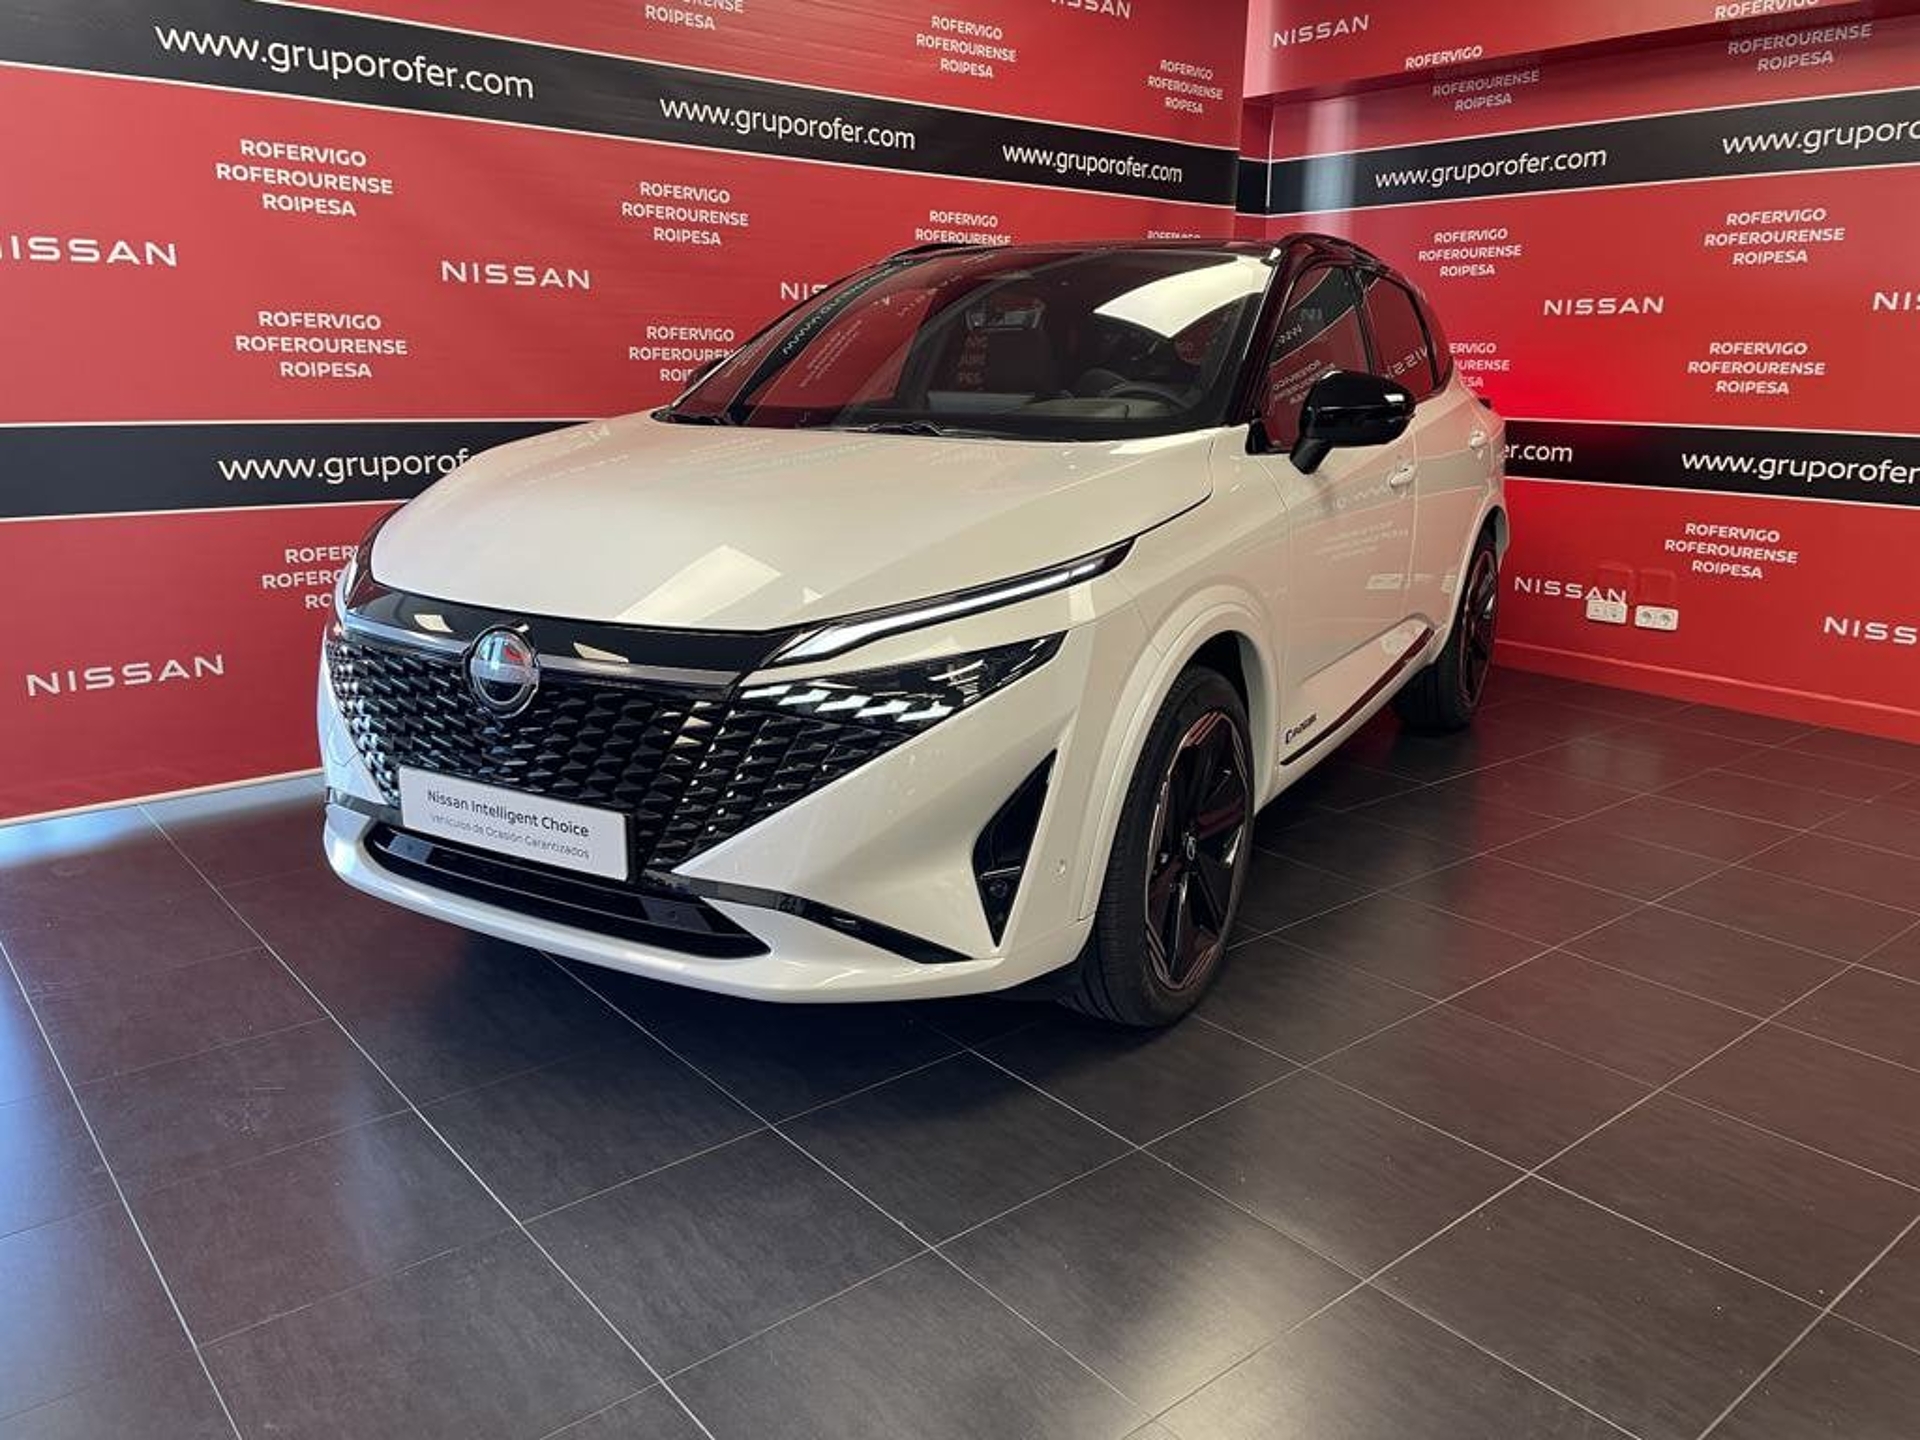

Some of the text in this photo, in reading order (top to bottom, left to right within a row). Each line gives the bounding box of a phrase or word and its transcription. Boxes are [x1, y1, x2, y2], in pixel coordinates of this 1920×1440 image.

[645, 5, 716, 30] ROIPESA
[1051, 0, 1131, 19] SSAN
[931, 15, 1003, 41] ROFERVIGO
[1272, 14, 1370, 48] NISSAN
[916, 33, 1016, 63] ROFEROURENSE
[1728, 24, 1873, 55] ROFEROURENSE
[155, 26, 535, 99] www.gruporofer.com
[1405, 44, 1484, 70] ROFERVIGO
[1757, 50, 1834, 72] ROIPESA
[940, 58, 994, 79] ROIPESA
[1159, 59, 1214, 81] ROFERVIGO
[1147, 75, 1224, 100] ROFEROURENSE
[1431, 69, 1541, 98] ROFEROURENSE
[1164, 97, 1204, 114] ROIPESA
[1453, 93, 1513, 112] ROIPESA
[660, 98, 916, 151] www.gruporofer.com
[1722, 120, 1920, 155] www.gruporo
[239, 138, 367, 168] ROFERVIGO
[1002, 143, 1184, 184] www.gruporofer.com
[215, 162, 394, 195] ROFEROURENSE
[1375, 147, 1608, 189] www.gruporofer.com
[639, 181, 731, 204] ROFERVIGO
[262, 192, 357, 217] ROIPESA
[621, 201, 749, 228] ROFEROURENSE
[929, 209, 998, 228] ROFERVIGO
[1726, 207, 1827, 226] ROFERVIGO
[653, 226, 722, 246] ROIPESA
[1433, 227, 1508, 244] ROFERVIGO
[1704, 227, 1846, 247] ROFEROURENSE
[0, 235, 177, 267] ISSAN
[1418, 244, 1522, 262] ROFEROURENSE
[1732, 249, 1808, 266] ROIPESA
[441, 260, 591, 290] NISSAN
[1439, 263, 1496, 278] ROIPESA
[1543, 296, 1664, 316] NISSAN
[258, 310, 382, 332] ROFERVIGO
[646, 325, 735, 342] ROFERVIGO
[235, 335, 408, 356] ROFEROURENSE
[1450, 342, 1497, 355] ERVIGO
[1709, 341, 1808, 357] ROFERVIGO
[279, 361, 372, 378] ROIPESA
[1456, 359, 1511, 372] URENSE
[1687, 361, 1826, 377] ROFEROURENSE
[1715, 380, 1790, 395] ROIPESA
[217, 447, 469, 484] www.gruporof
[1681, 453, 1920, 484] www.gruporofer
[1685, 522, 1780, 544] ROFERVIGO
[285, 546, 358, 563] ROFER
[1664, 539, 1799, 564] ROFEROURENSE
[1691, 559, 1763, 579] ROIPESA
[1514, 576, 1627, 603] NISSAN
[1823, 616, 1918, 646] NISS
[26, 654, 225, 697] NISSAN
[427, 790, 589, 837] Nissan Intelligent Choice
